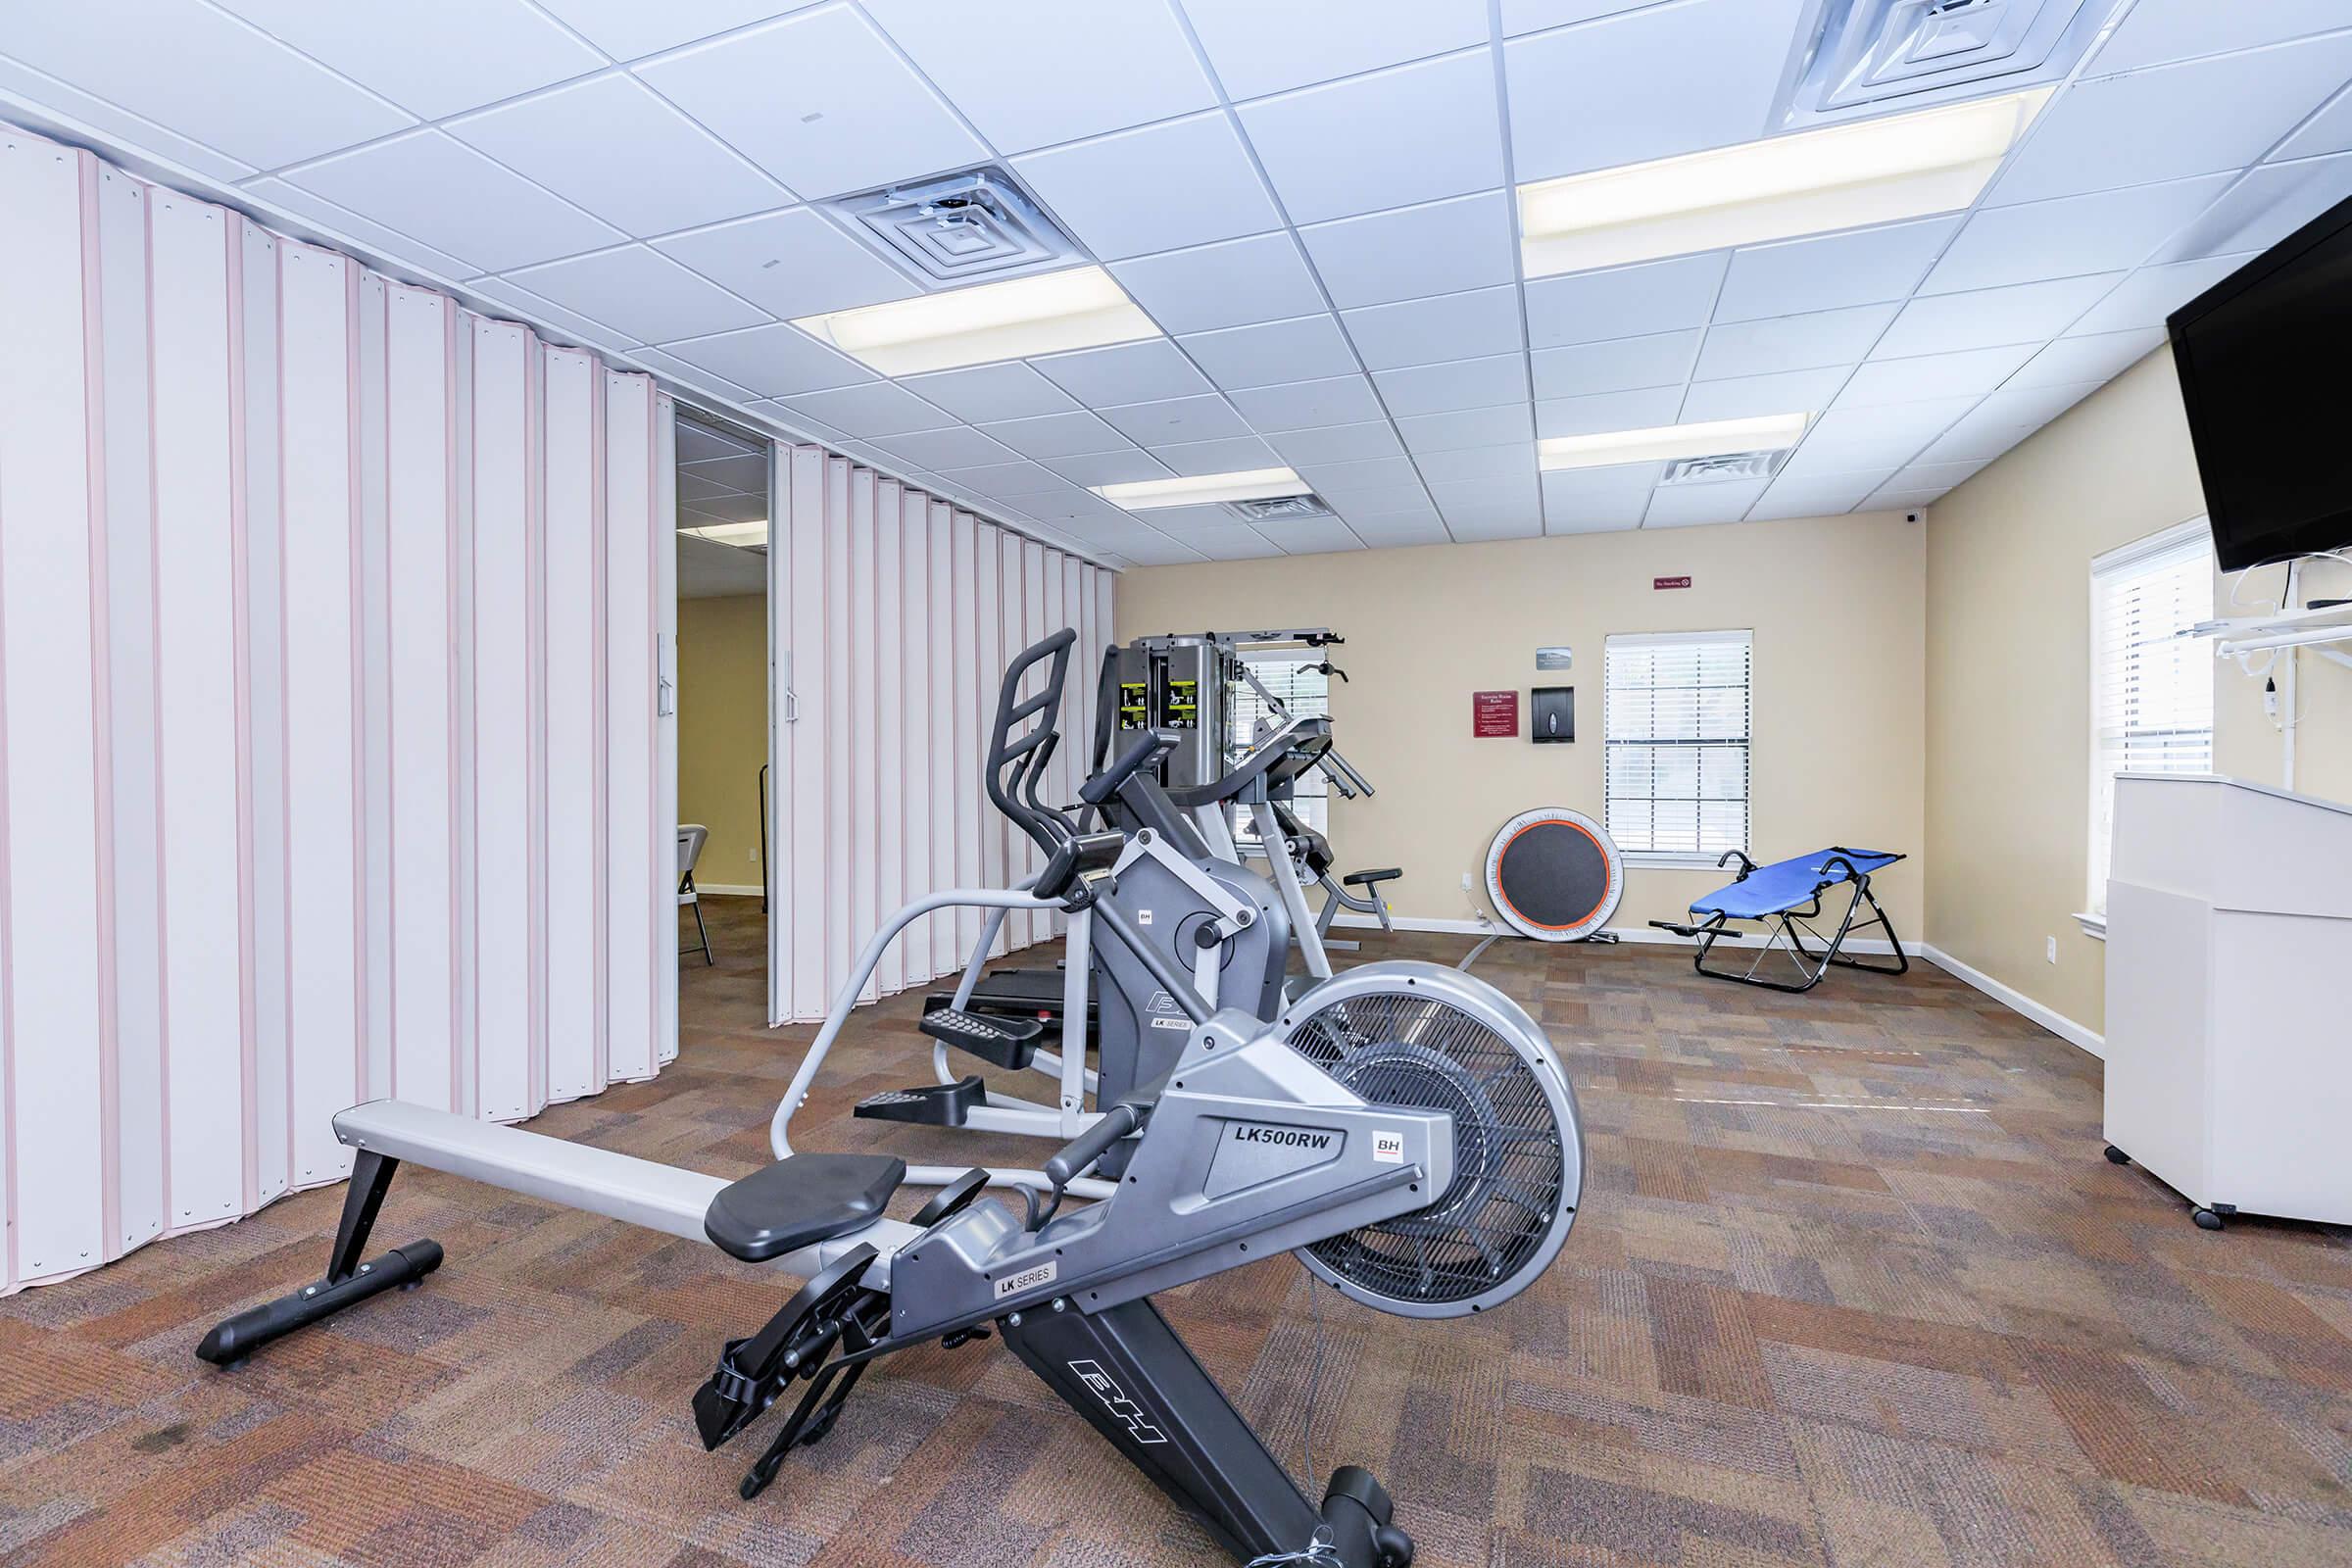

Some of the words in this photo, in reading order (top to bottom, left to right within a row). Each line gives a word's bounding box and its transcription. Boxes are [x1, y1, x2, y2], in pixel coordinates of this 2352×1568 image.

[1235, 1126, 1331, 1150] LK500RW
[1377, 1139, 1399, 1152] BH
[1002, 1280, 1014, 1294] LK
[1017, 1268, 1050, 1288] SERIES
[1067, 1359, 1168, 1444] BH
